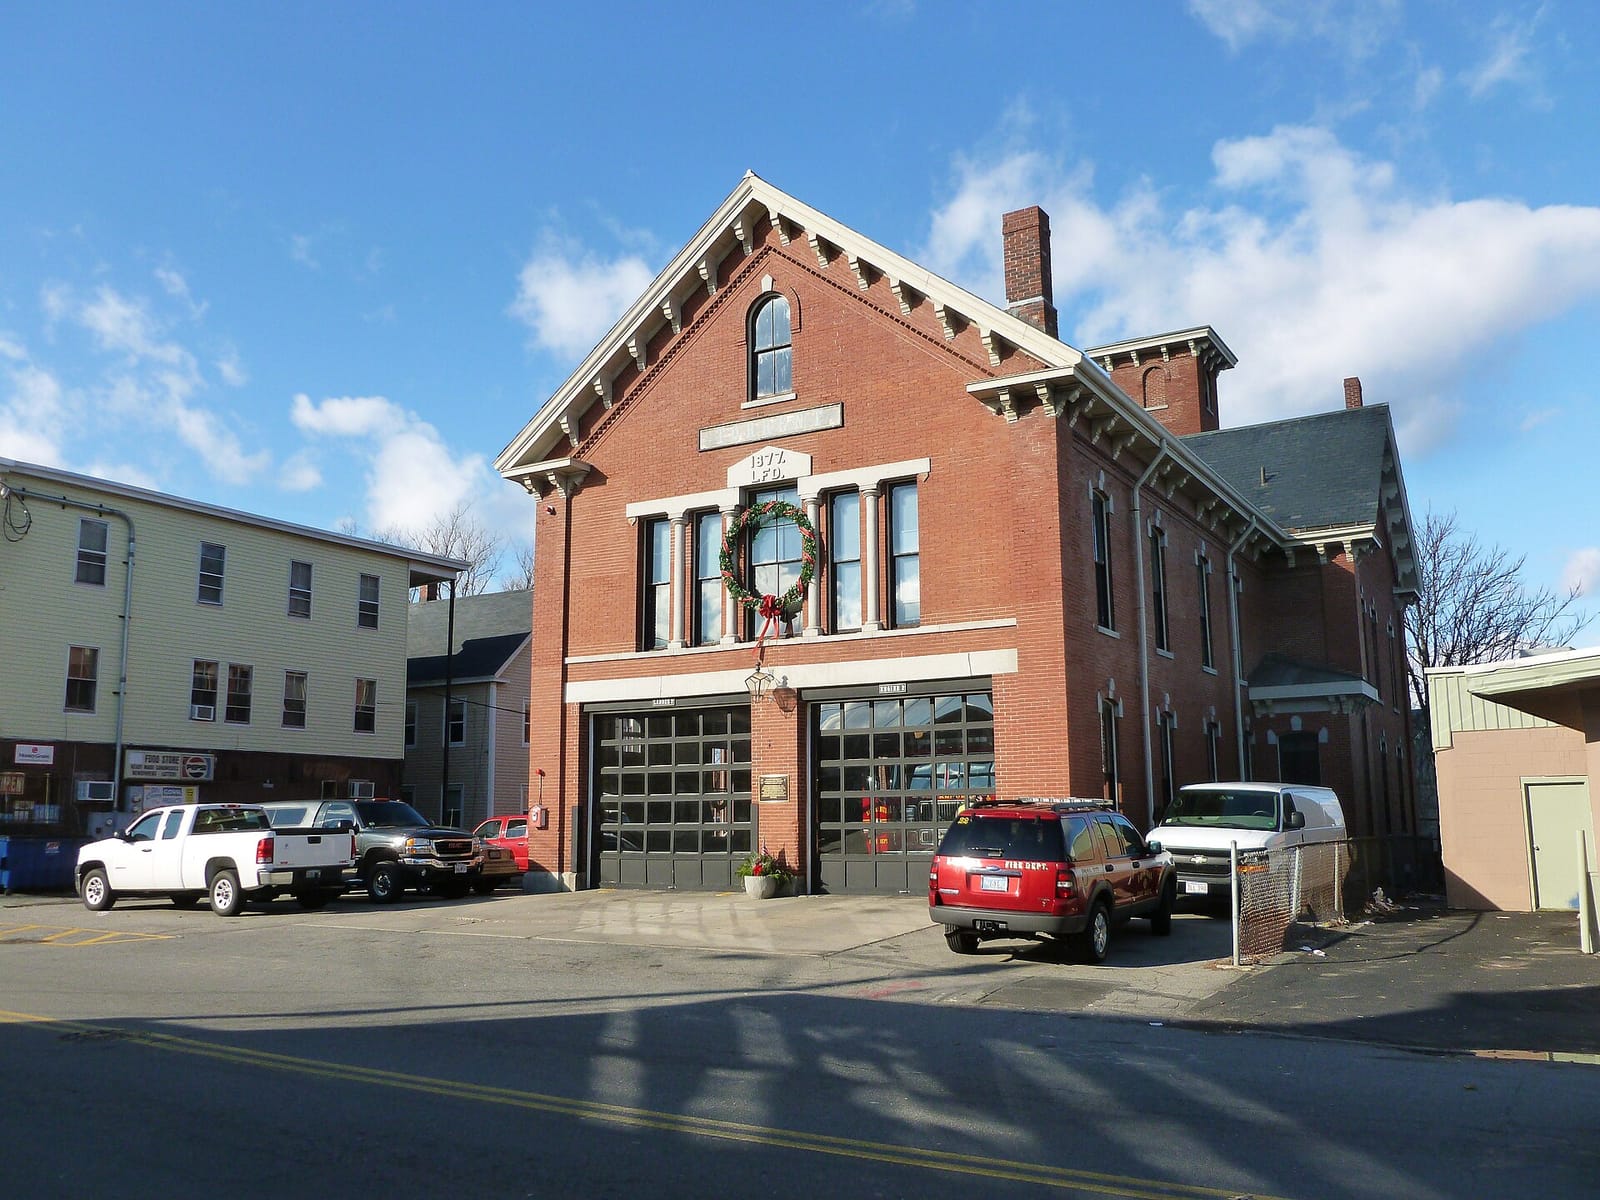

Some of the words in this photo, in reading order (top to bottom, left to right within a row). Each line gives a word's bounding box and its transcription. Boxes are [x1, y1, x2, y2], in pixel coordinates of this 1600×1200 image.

[144, 754, 160, 763] FOOD
[162, 755, 180, 764] STORE
[1004, 860, 1024, 869] FIRE
[1025, 862, 1049, 870] DEPT.
